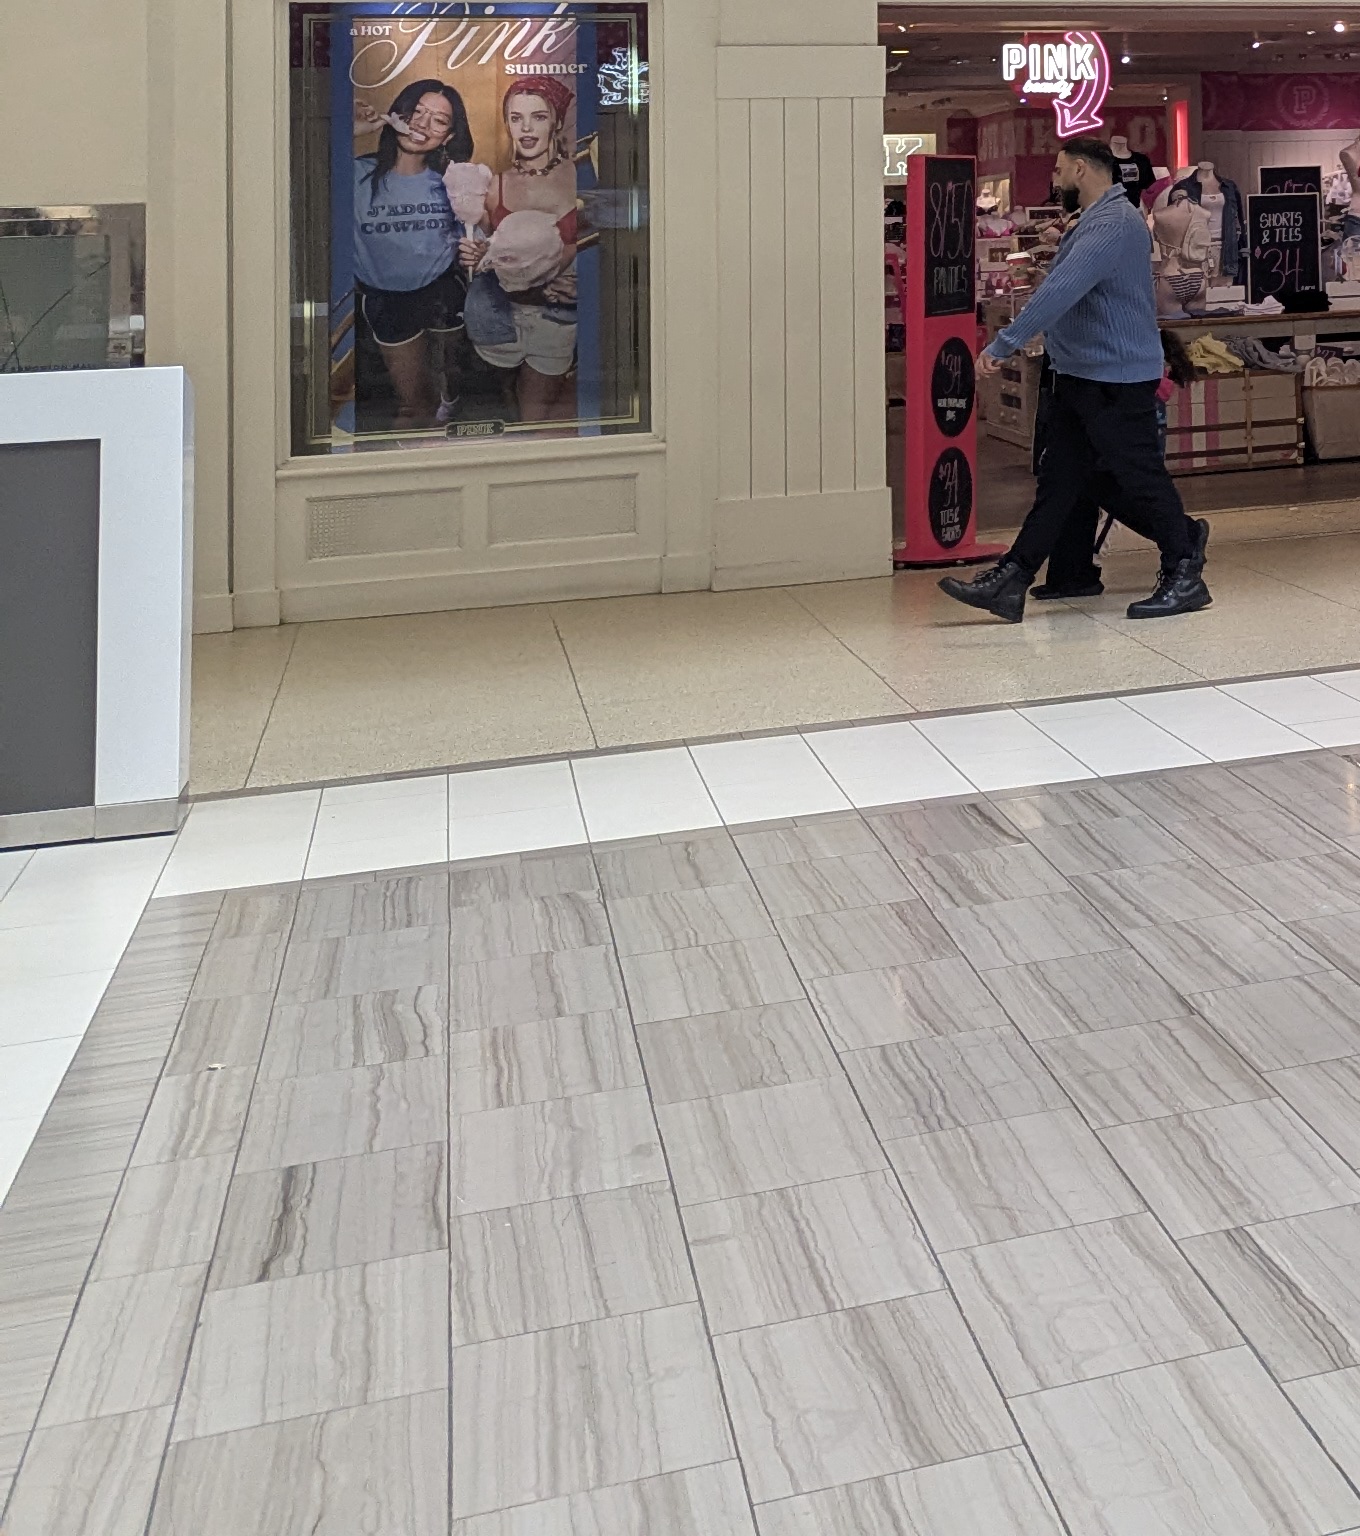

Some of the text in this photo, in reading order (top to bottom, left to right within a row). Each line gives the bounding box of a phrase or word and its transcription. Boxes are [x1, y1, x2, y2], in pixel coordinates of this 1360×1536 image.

[361, 26, 392, 36] HOT
[505, 63, 588, 75] summer
[1002, 44, 1097, 81] PINK
[1260, 212, 1303, 228] SHORTS
[1261, 227, 1303, 244] & TEES
